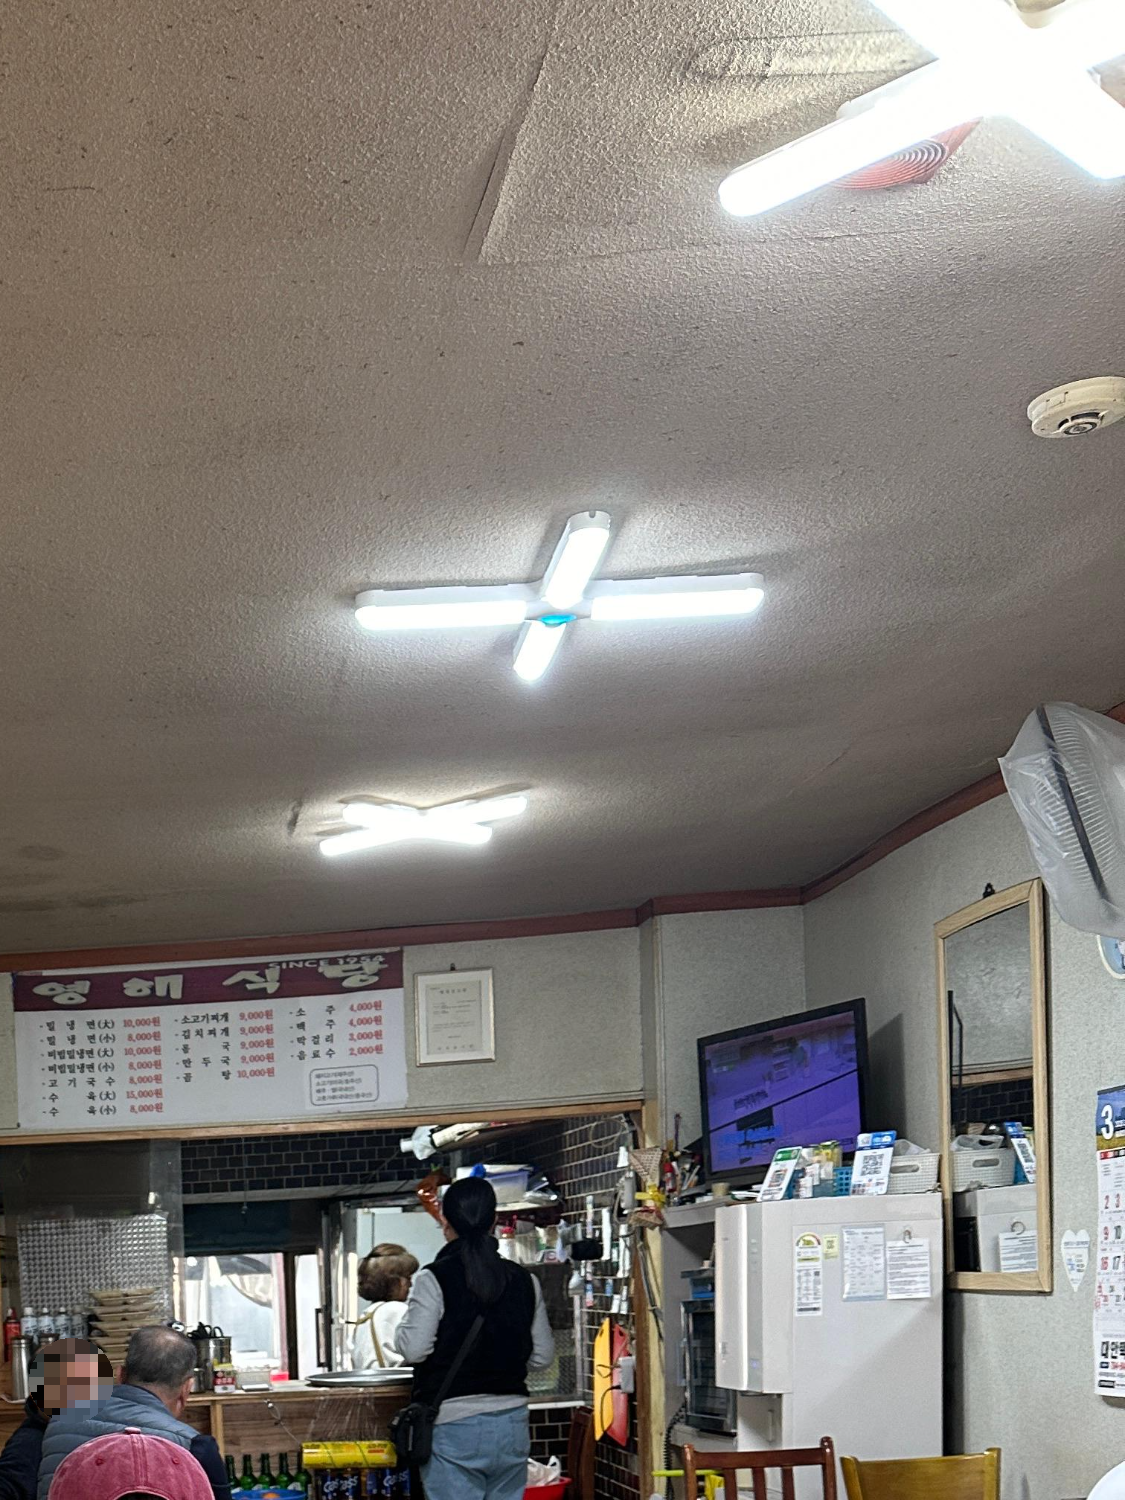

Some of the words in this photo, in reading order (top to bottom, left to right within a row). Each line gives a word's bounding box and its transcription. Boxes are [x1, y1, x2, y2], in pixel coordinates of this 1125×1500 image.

[268, 957, 330, 970] SINCE
[349, 1000, 383, 1013] 4,000원
[239, 1009, 273, 1021] 9,000원
[123, 1016, 161, 1028] 10,000원
[349, 1015, 383, 1028] 4,000원
[239, 1023, 274, 1036] 9,000원
[127, 1031, 162, 1042] 8,000원
[240, 1038, 274, 1050] 9,000원
[124, 1045, 162, 1057] 10,000원
[240, 1052, 275, 1064] 9,000원
[128, 1059, 162, 1071] 8,000원
[128, 1073, 163, 1085] 8,000원
[237, 1067, 275, 1079] 10,000원
[126, 1088, 163, 1100] 15,000원
[130, 1102, 164, 1114] 8,000원
[1101, 1104, 1115, 1140] 3
